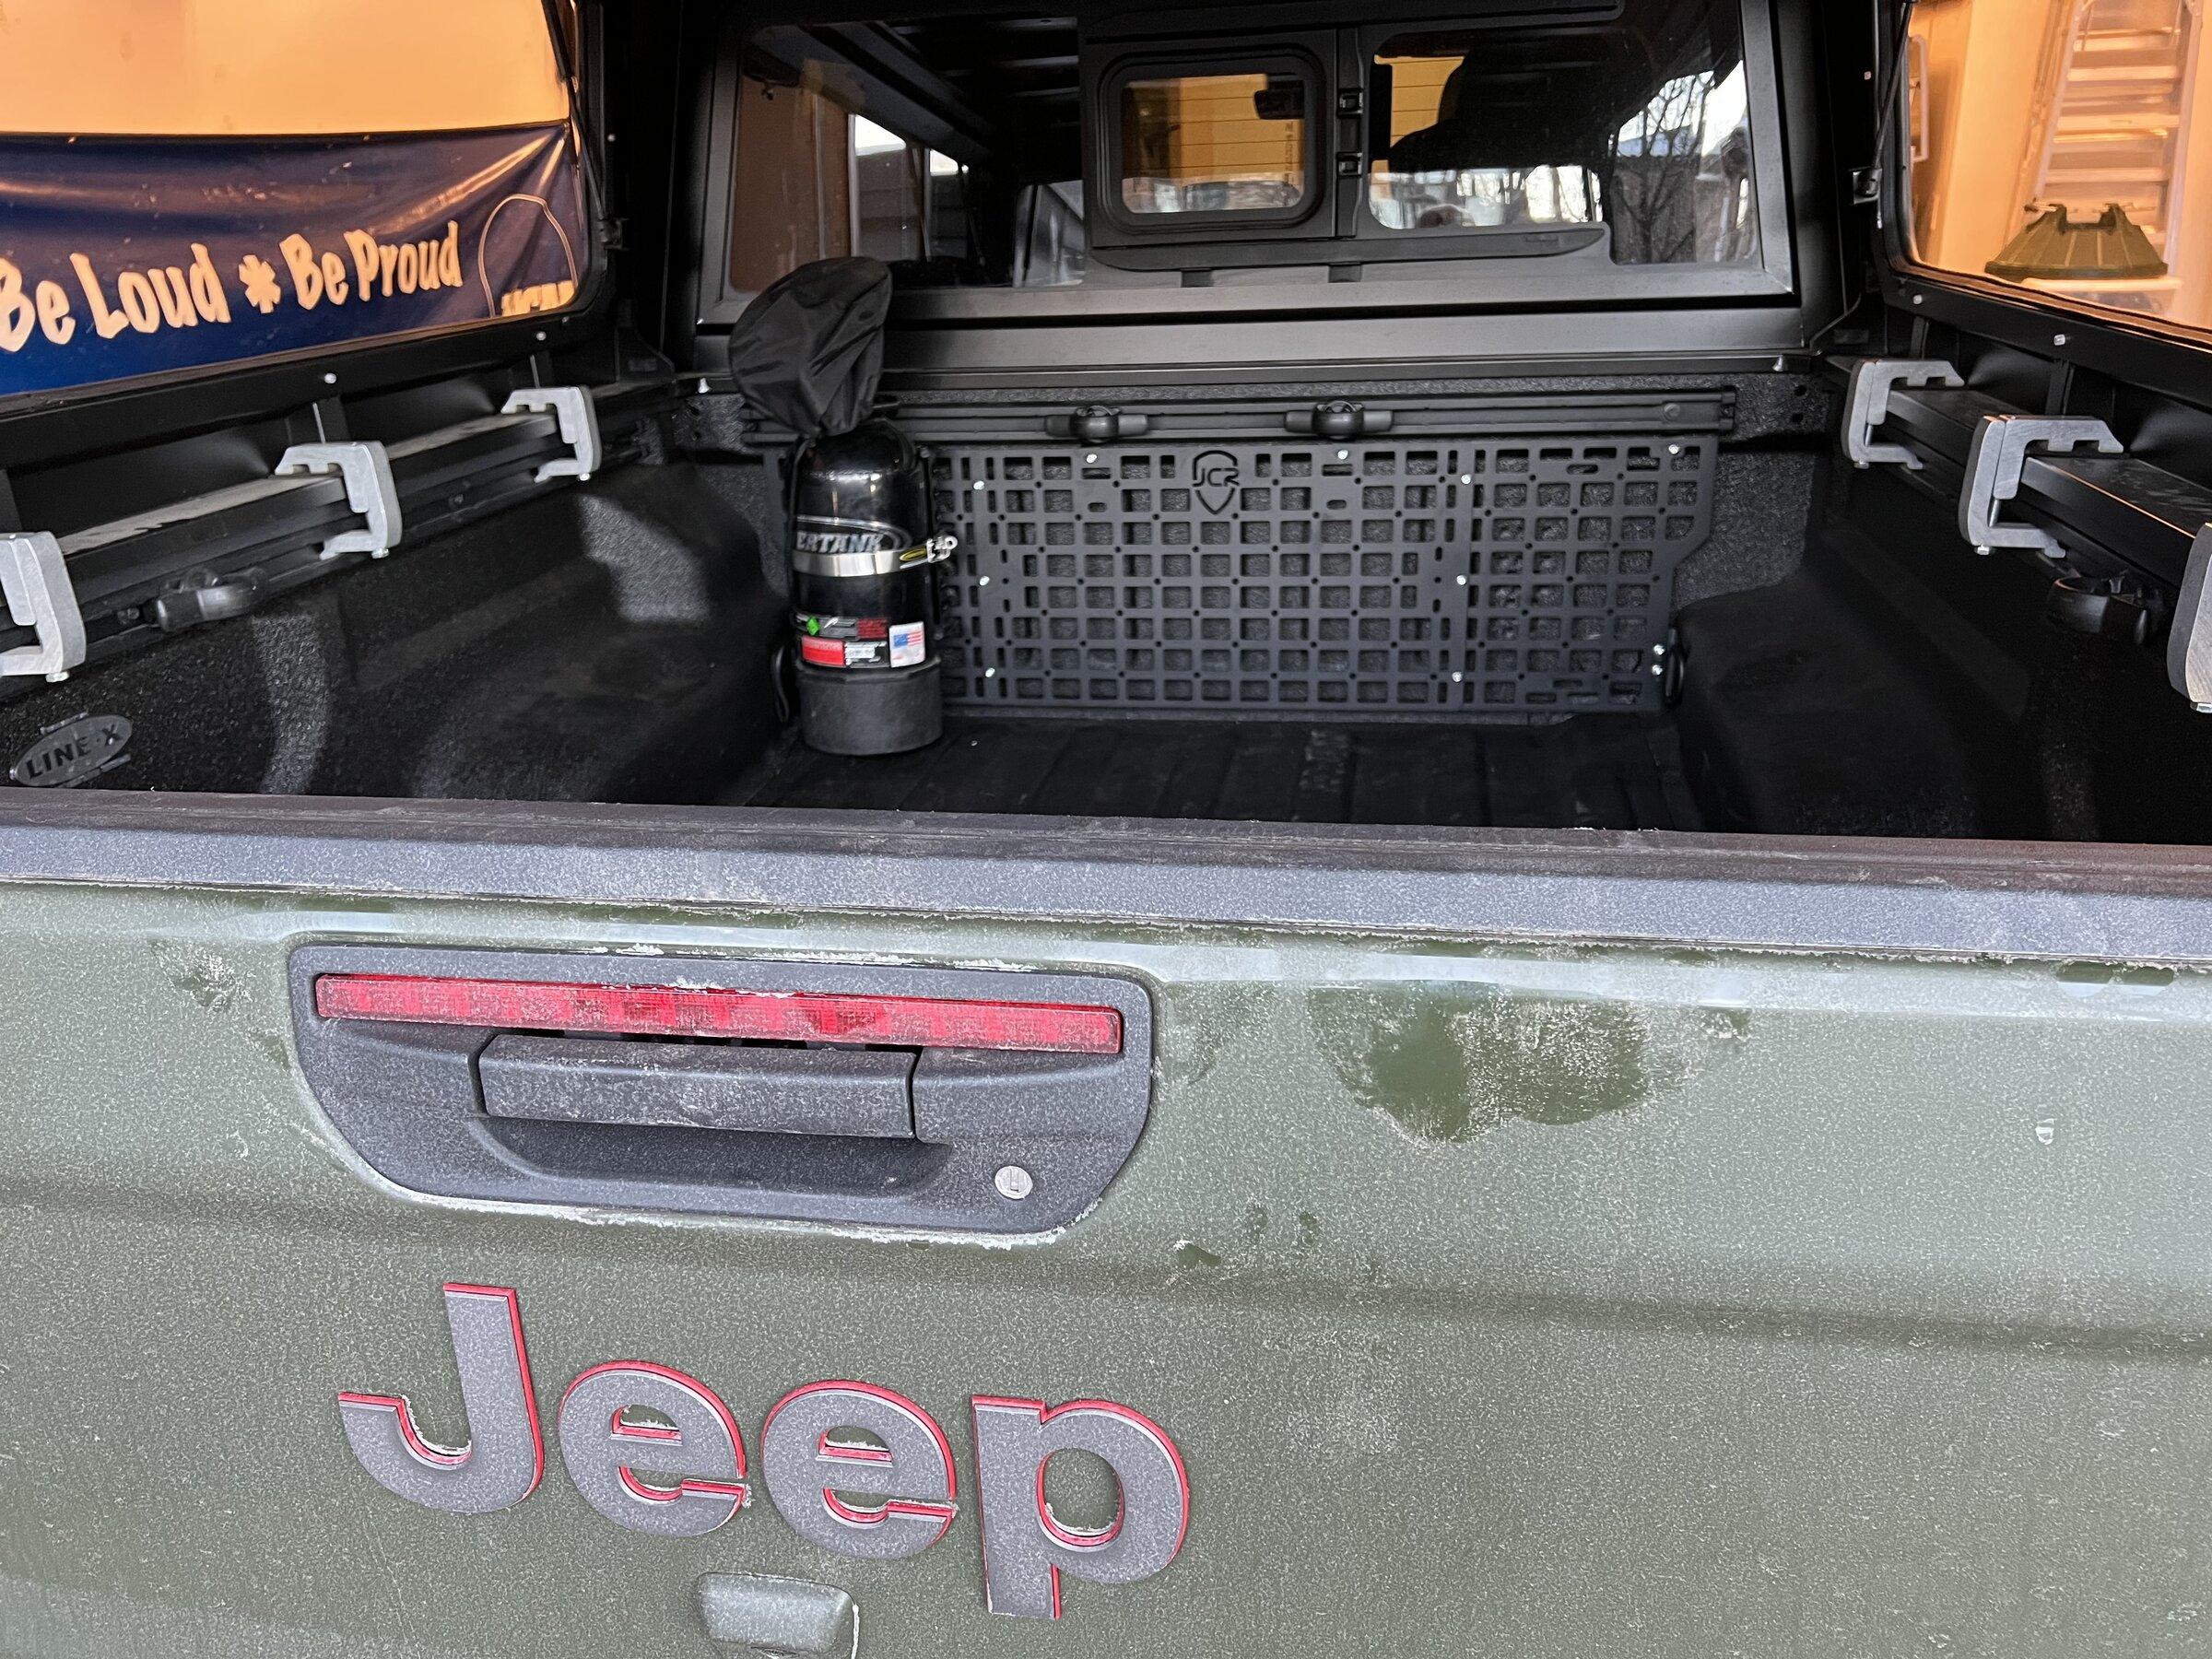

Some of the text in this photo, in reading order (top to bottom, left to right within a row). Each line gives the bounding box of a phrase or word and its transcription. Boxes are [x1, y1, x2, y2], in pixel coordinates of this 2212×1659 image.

[0, 257, 76, 352] Be
[70, 242, 231, 339] Loud
[279, 233, 348, 310] Be
[344, 220, 463, 302] Proud
[337, 1281, 1191, 1620] Jeep
